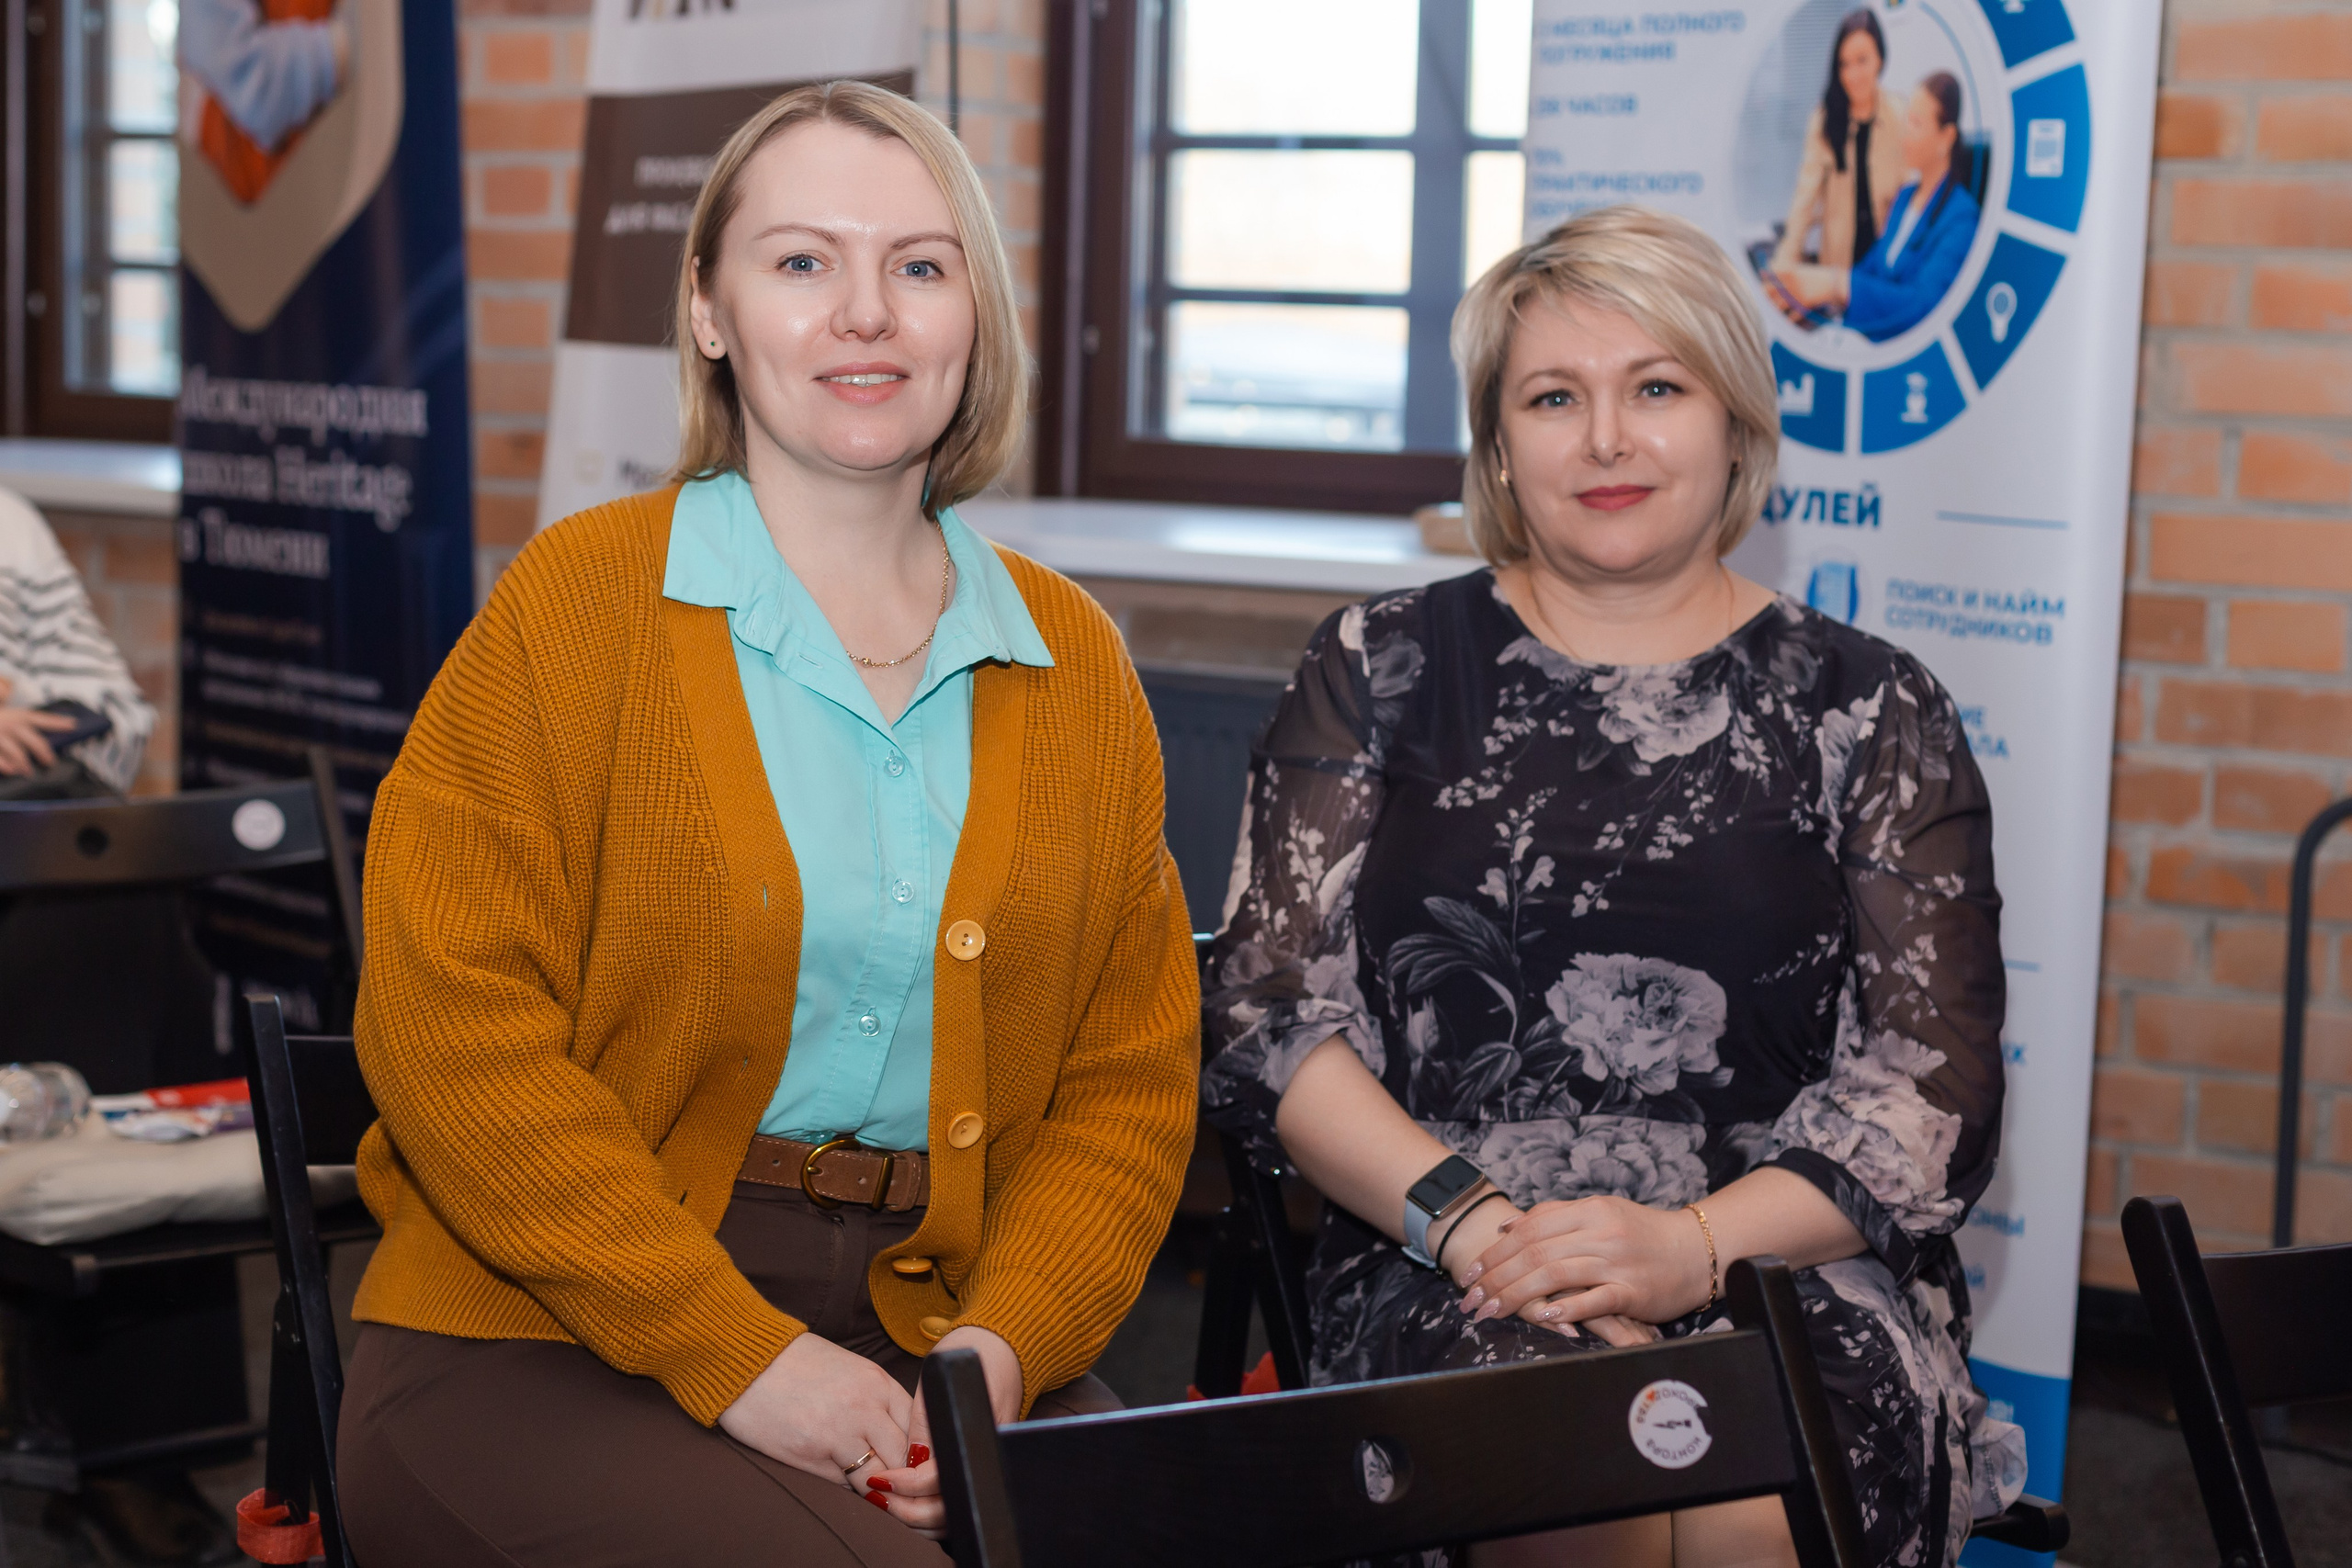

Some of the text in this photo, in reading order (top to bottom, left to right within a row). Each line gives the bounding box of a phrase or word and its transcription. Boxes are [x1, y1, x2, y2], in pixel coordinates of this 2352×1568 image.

[1886, 578, 2064, 620] ПОИСК И НАЙМ
[1886, 605, 2053, 646] СОТРУДНИКОВ
